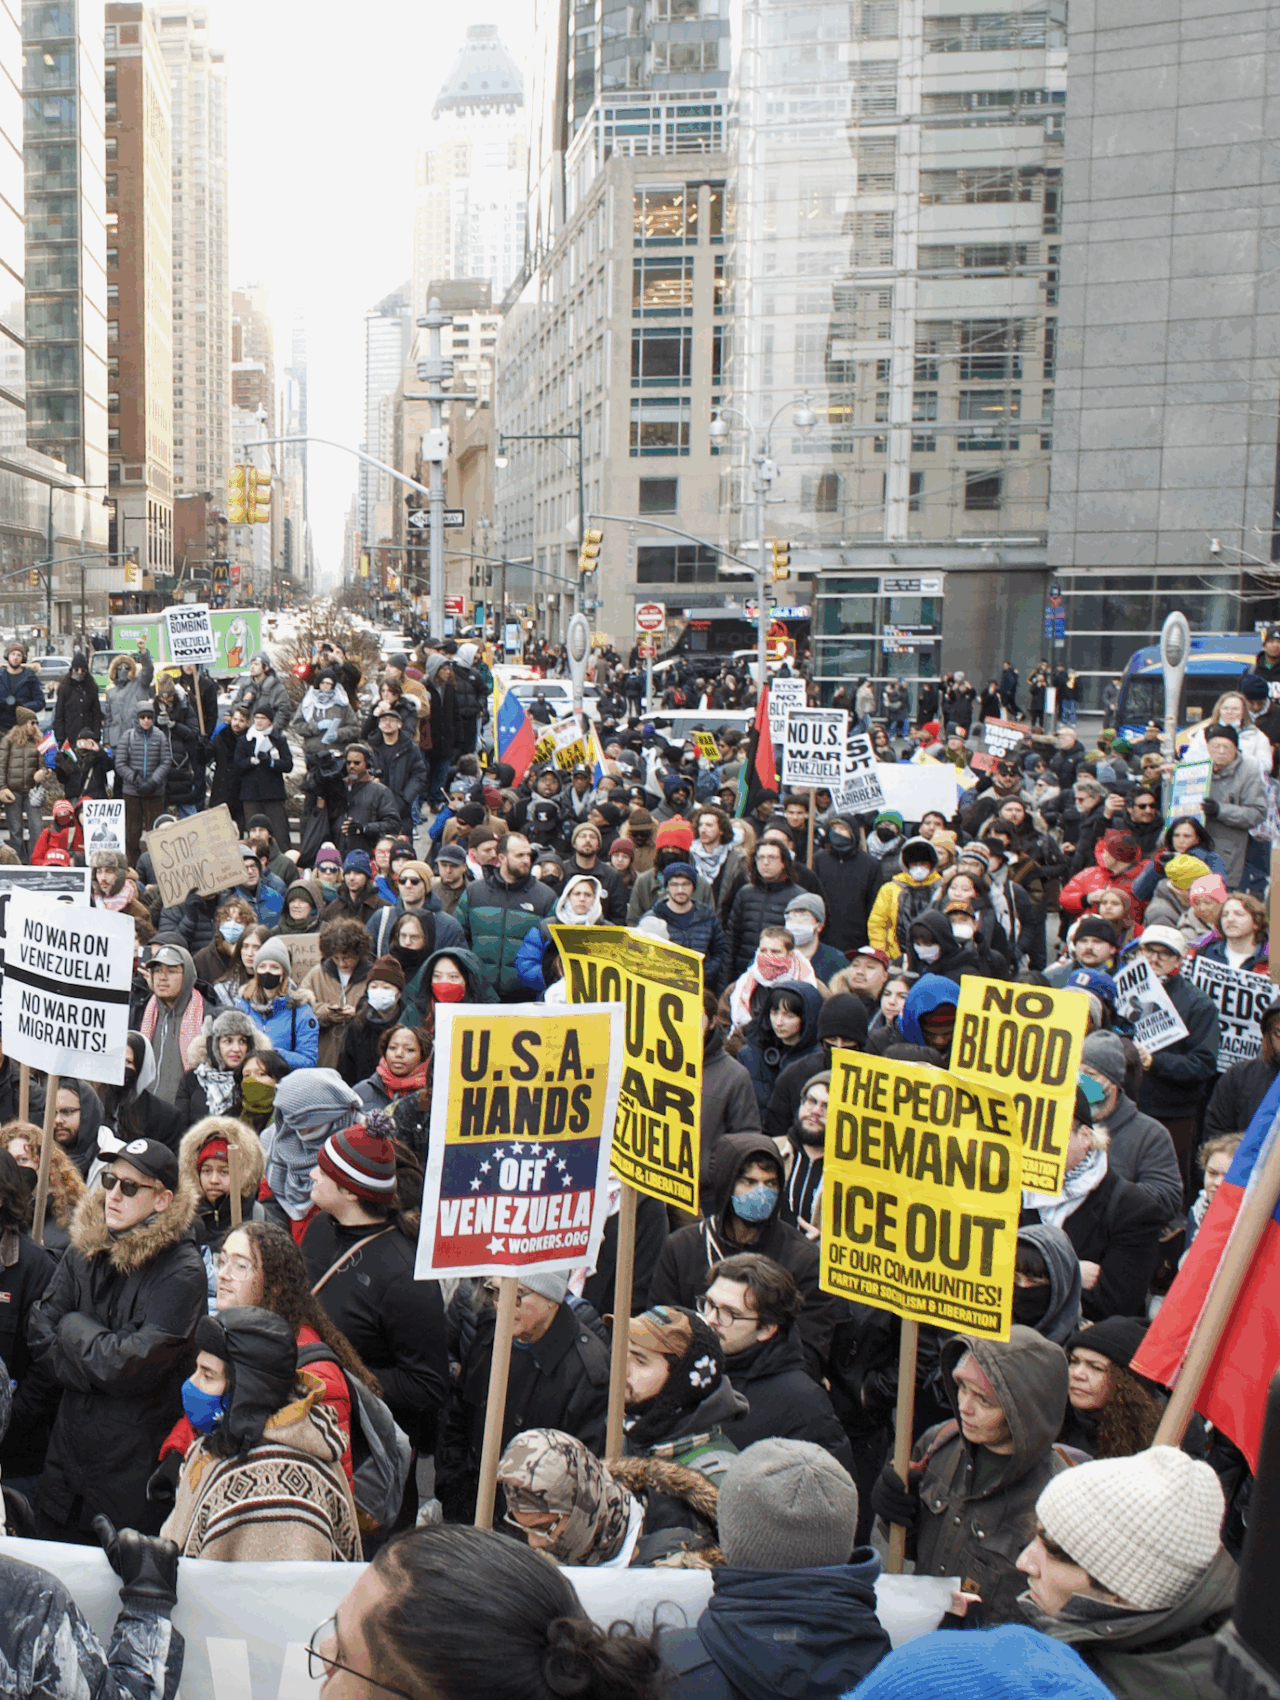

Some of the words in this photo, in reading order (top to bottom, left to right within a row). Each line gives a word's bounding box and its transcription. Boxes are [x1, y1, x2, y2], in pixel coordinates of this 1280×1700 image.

[414, 515, 430, 523] ONE
[169, 611, 206, 620] STOP
[170, 620, 208, 634] BOMBING
[173, 636, 210, 648] VENEZUELA
[174, 647, 211, 656] NOW!
[788, 722, 808, 744] NO
[812, 724, 842, 746] U.S.
[984, 734, 1017, 750] MUST
[985, 724, 1024, 740] TRUMP
[787, 761, 840, 776] VENEZUELA
[788, 749, 841, 761] WAR
[988, 745, 1006, 758] GO
[864, 773, 877, 785] THE
[86, 803, 122, 817] STAND
[835, 785, 882, 808] CARIBBEAN
[160, 831, 198, 869] STOP
[159, 858, 215, 904] BOMBING
[24, 918, 43, 943] NO
[46, 926, 81, 954] WAR
[84, 934, 109, 957] ON
[20, 943, 110, 983] VENEZUELA!
[1120, 962, 1147, 995] AND
[1198, 967, 1273, 993] PEOPLE'S
[1200, 960, 1240, 977] MONEY
[982, 985, 1054, 1019] NO
[1137, 983, 1151, 995] THE
[22, 990, 40, 1015] NO
[43, 998, 78, 1024] WAR
[81, 1006, 106, 1029] ON
[19, 1013, 107, 1053] MIGRANTS!
[626, 977, 696, 1078] U.S.
[461, 1029, 595, 1082] U.S.A.
[957, 1013, 1072, 1086] BLOOD
[460, 1084, 592, 1137] HANDS
[622, 1066, 695, 1126] AR
[840, 1062, 889, 1112] THE
[893, 1076, 1011, 1137] PEOPLE
[1014, 1093, 1061, 1156] OIL
[835, 1110, 1010, 1194] DEMAND
[499, 1158, 547, 1192] OFF
[635, 1166, 644, 1183] &
[645, 1169, 692, 1202] LIBERATION
[440, 1191, 591, 1236] VENEZUELA
[832, 1181, 897, 1253] ICE
[906, 1203, 1006, 1277] OUT
[508, 1231, 589, 1254] WORKERS.ORG
[830, 1243, 848, 1264] OF
[850, 1249, 881, 1275] OUR
[884, 1258, 1002, 1307] COMMUNITIES!
[831, 1271, 858, 1288] PARTY
[860, 1279, 879, 1294] FOR
[880, 1283, 927, 1311] SOCIALISM
[928, 1298, 937, 1312] &
[938, 1300, 998, 1328] LIBERATION
